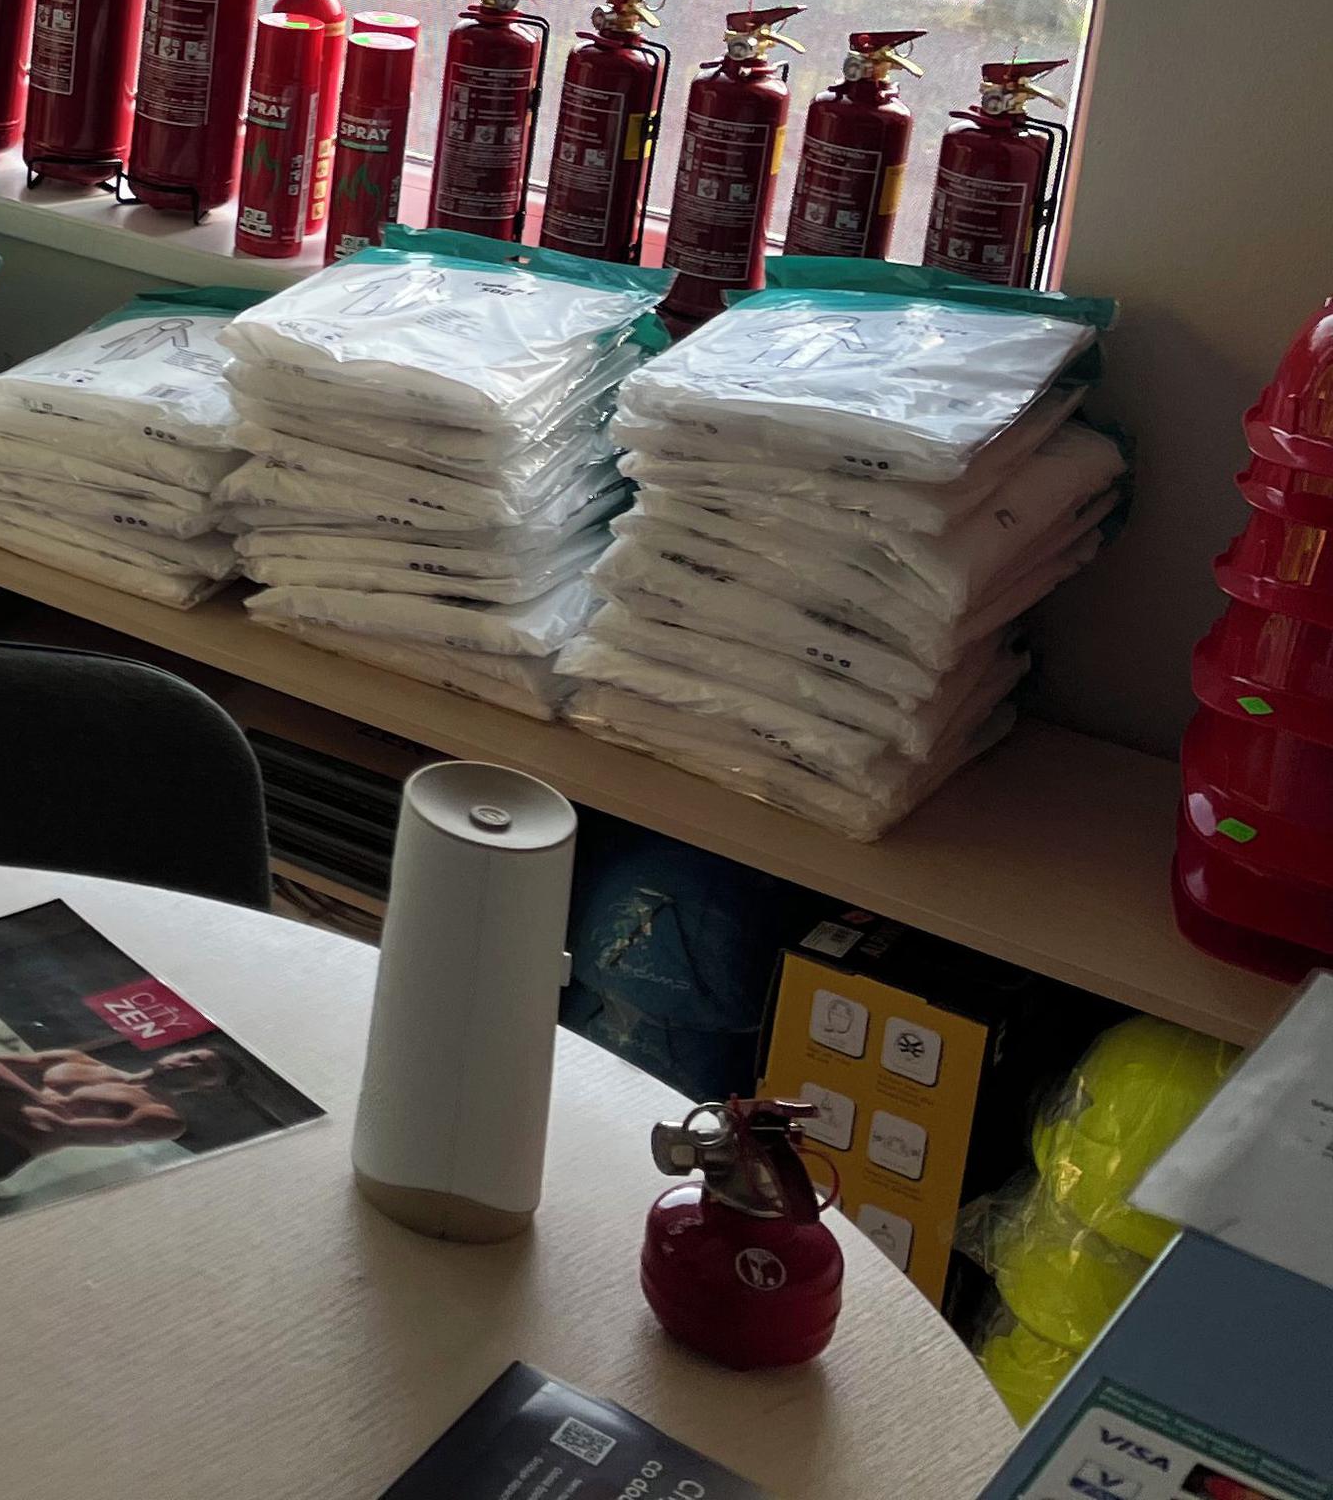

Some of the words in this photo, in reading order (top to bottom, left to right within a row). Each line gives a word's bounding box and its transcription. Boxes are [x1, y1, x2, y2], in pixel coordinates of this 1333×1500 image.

[340, 122, 391, 142] SPRAY
[103, 998, 167, 1039] ZEN
[1099, 1425, 1171, 1473] VISA
[641, 1460, 663, 1479] co
